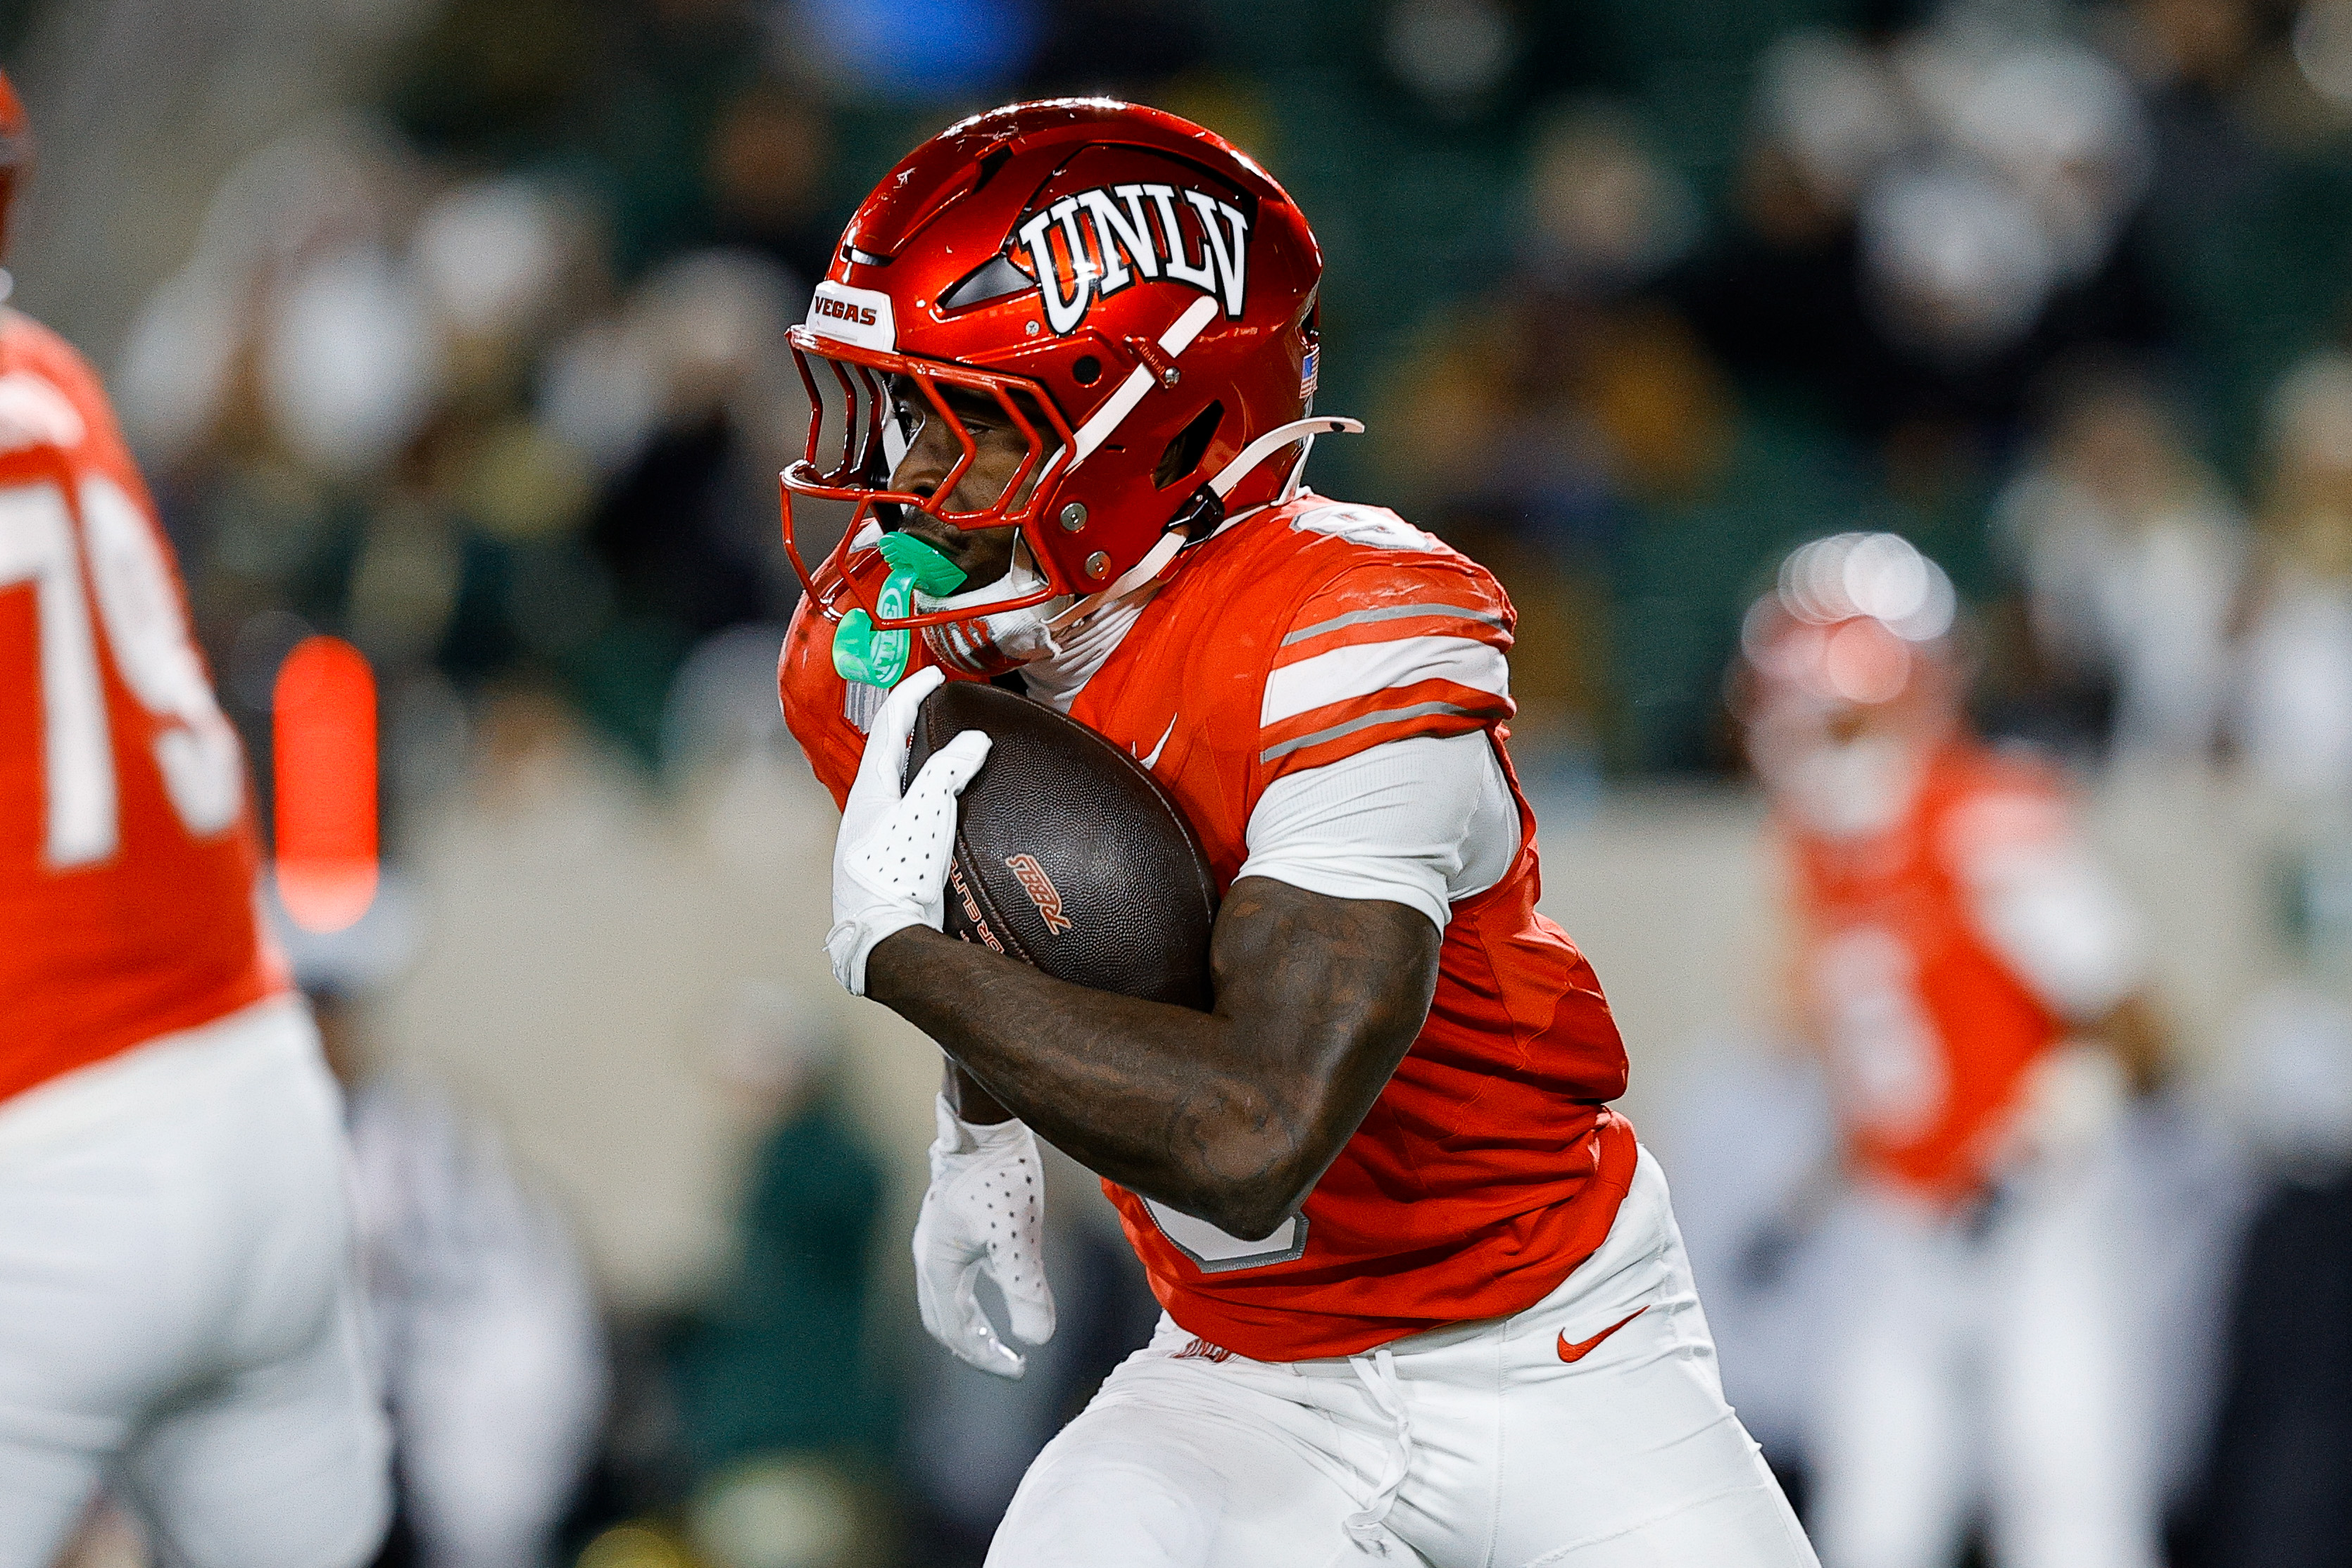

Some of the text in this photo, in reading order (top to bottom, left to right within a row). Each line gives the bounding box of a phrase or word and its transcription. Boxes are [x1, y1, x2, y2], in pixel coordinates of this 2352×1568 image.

[1018, 183, 1248, 334] UNLV
[815, 296, 877, 326] VEGAS
[1005, 853, 1071, 935] REBELS
